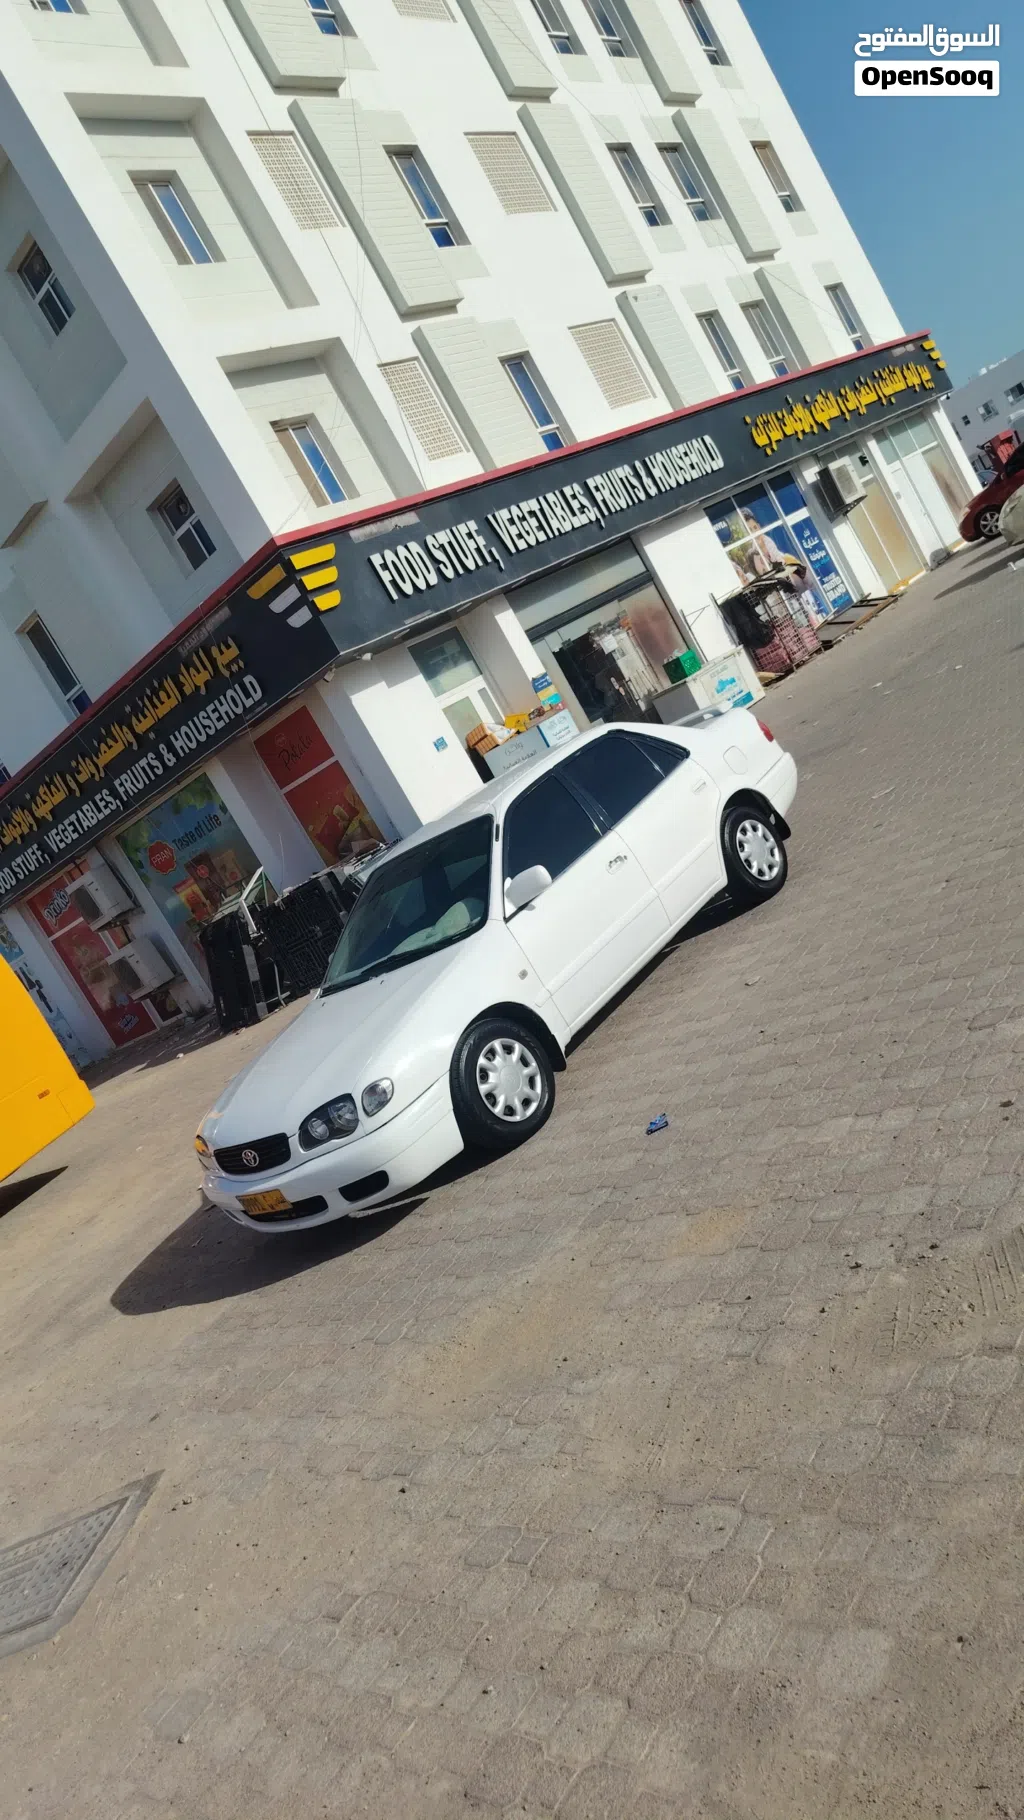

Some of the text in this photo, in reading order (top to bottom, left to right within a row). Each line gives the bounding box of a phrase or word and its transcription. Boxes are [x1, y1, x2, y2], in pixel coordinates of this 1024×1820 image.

[902, 361, 921, 393] المواد
[917, 364, 935, 390] بيع
[368, 434, 725, 601] FOOD STUFF, VEGETABLES, FRUITS & HOUSEHOLD
[178, 647, 215, 696] المواد
[210, 636, 245, 678] بيع
[124, 674, 183, 741] الغذائية
[69, 721, 138, 779] والخضروات
[11, 842, 51, 880] STUFF,
[44, 787, 124, 854] VEGETABLES,
[112, 751, 165, 802] FRUITS
[158, 742, 177, 768] &
[168, 673, 263, 758] HOUSEHOLD
[24, 771, 71, 822] الفاكهة
[65, 773, 82, 798] و
[171, 812, 222, 852] Taste of Life
[150, 846, 173, 867] PRAN
